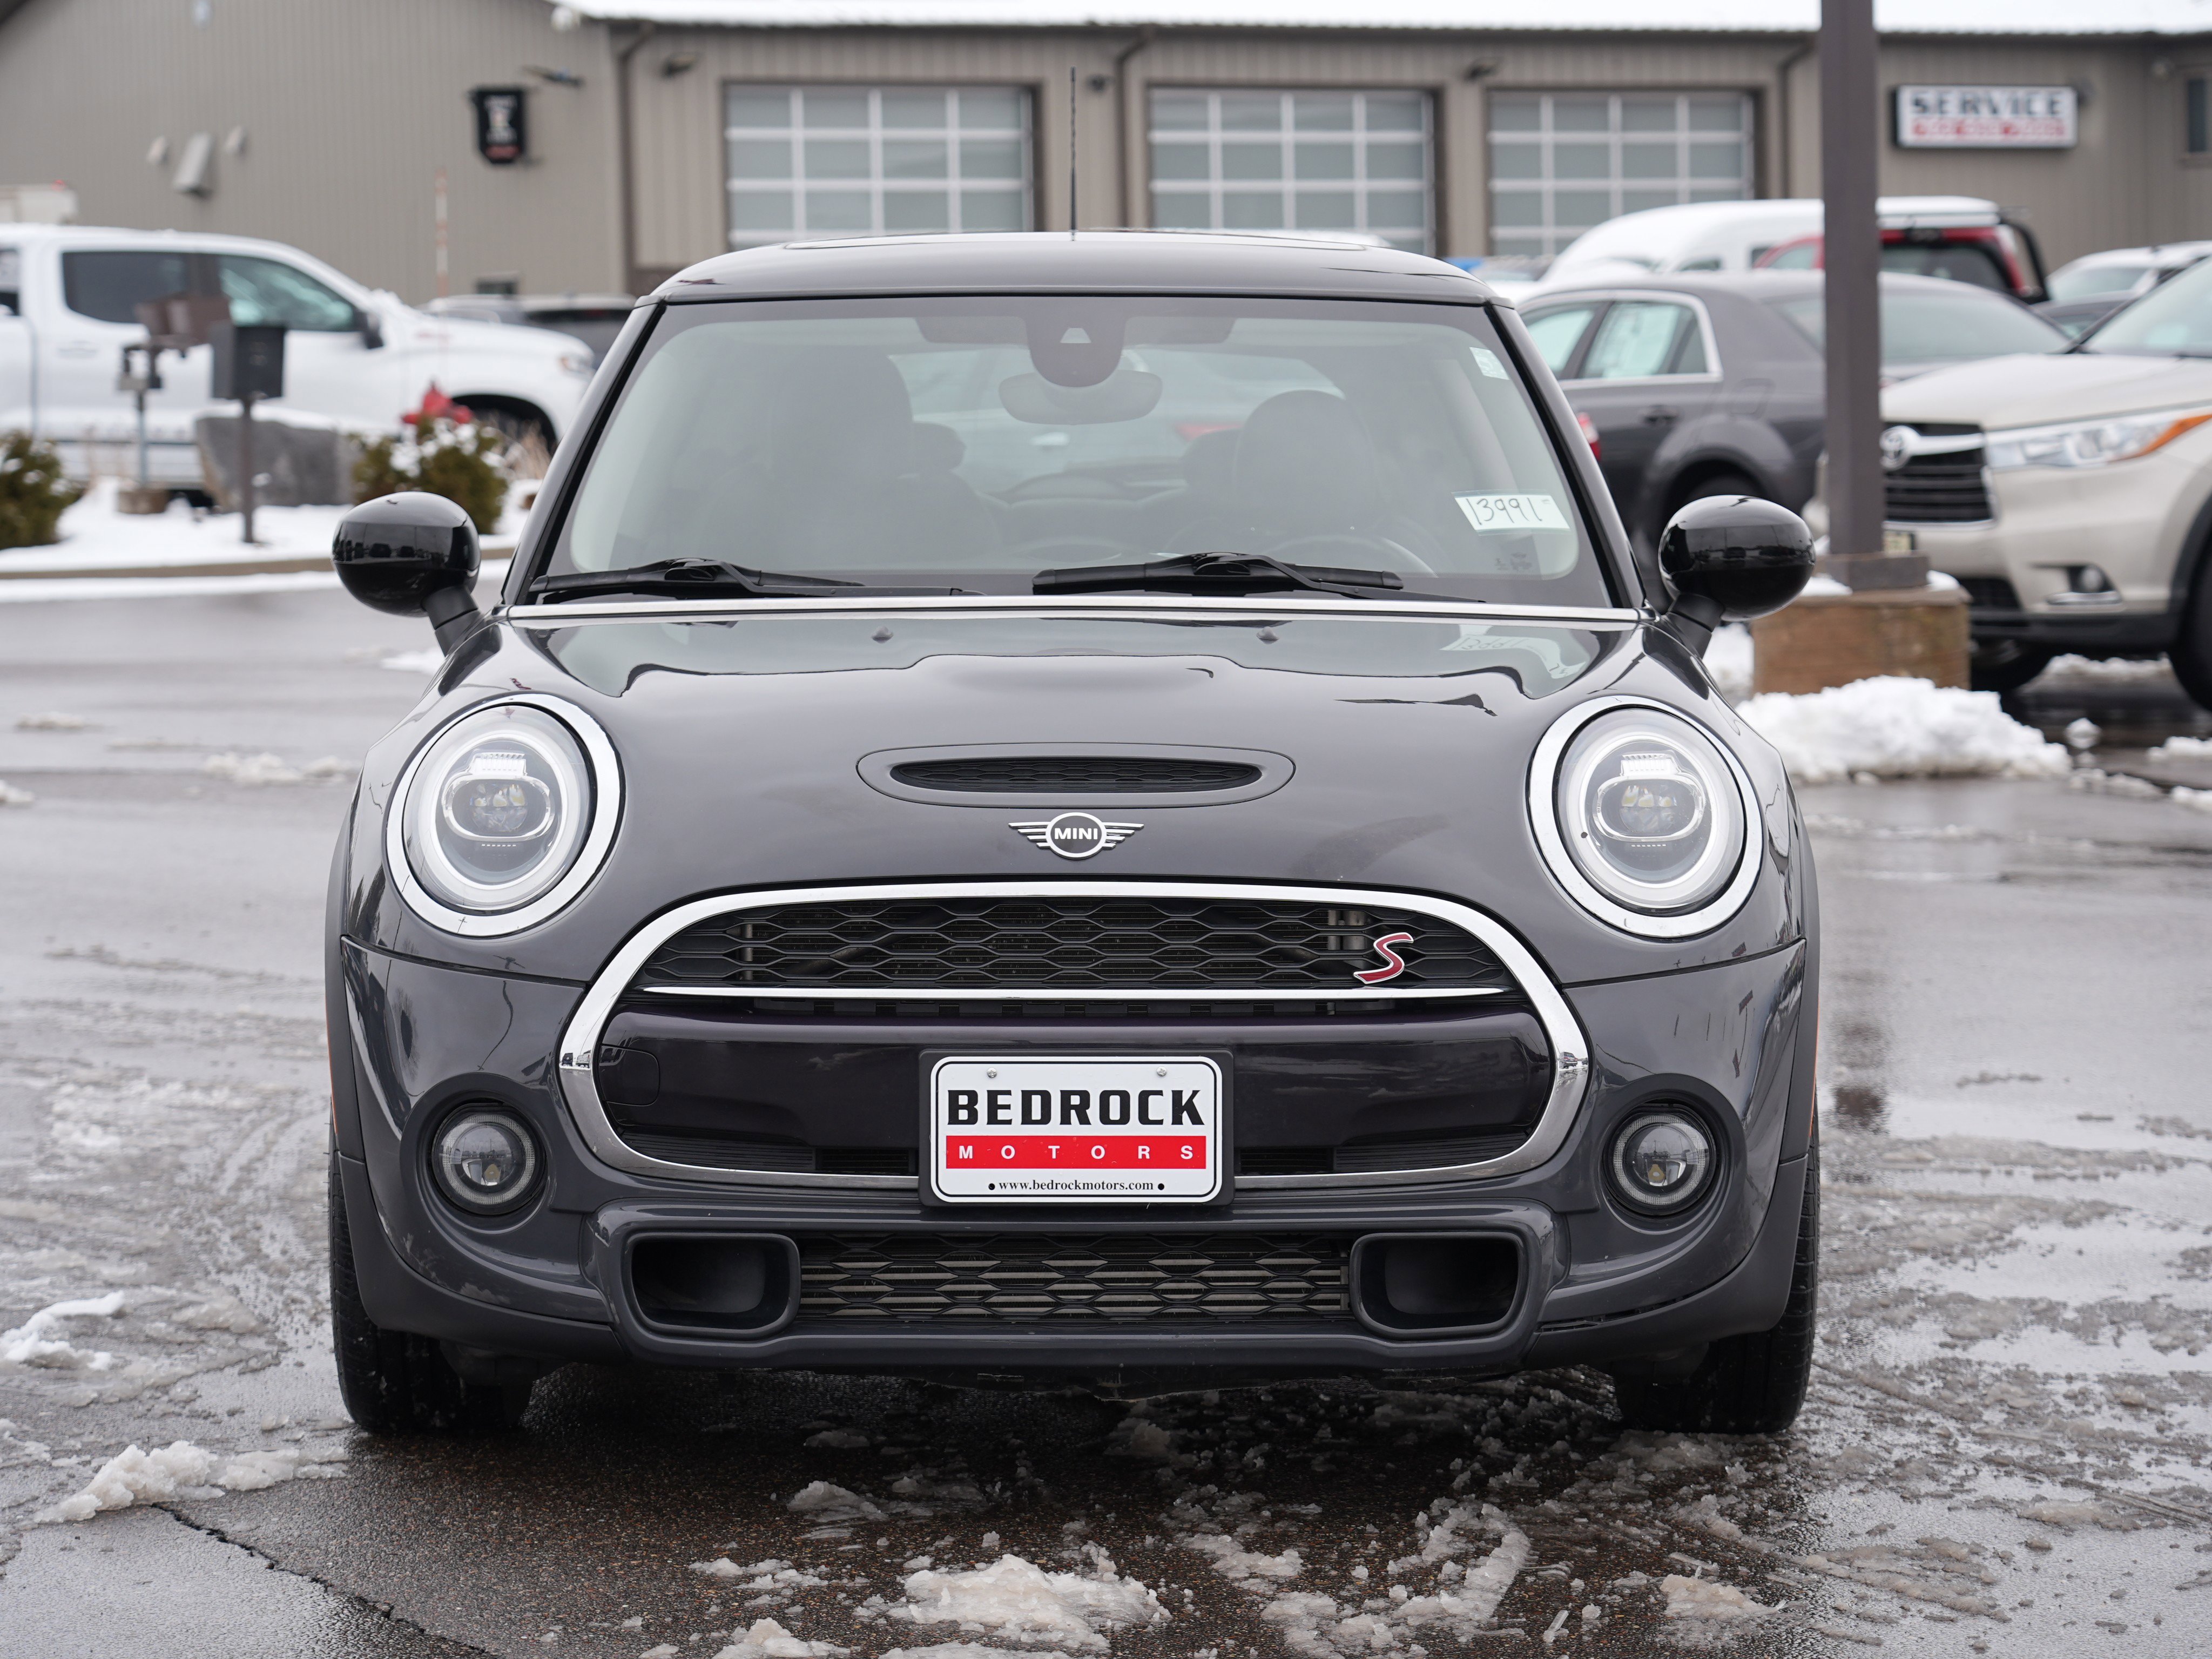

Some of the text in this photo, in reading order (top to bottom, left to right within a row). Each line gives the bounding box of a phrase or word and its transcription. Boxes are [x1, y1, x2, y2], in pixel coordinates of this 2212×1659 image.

[1911, 91, 2062, 116] SERVICE
[1466, 497, 1543, 525] 13991
[1054, 827, 1098, 840] MINI
[1353, 932, 1414, 984] S
[947, 1089, 1205, 1125] BEDROCK
[959, 1145, 1193, 1160] MOTORS
[998, 1179, 1154, 1191] www.bedrockmotors.com
